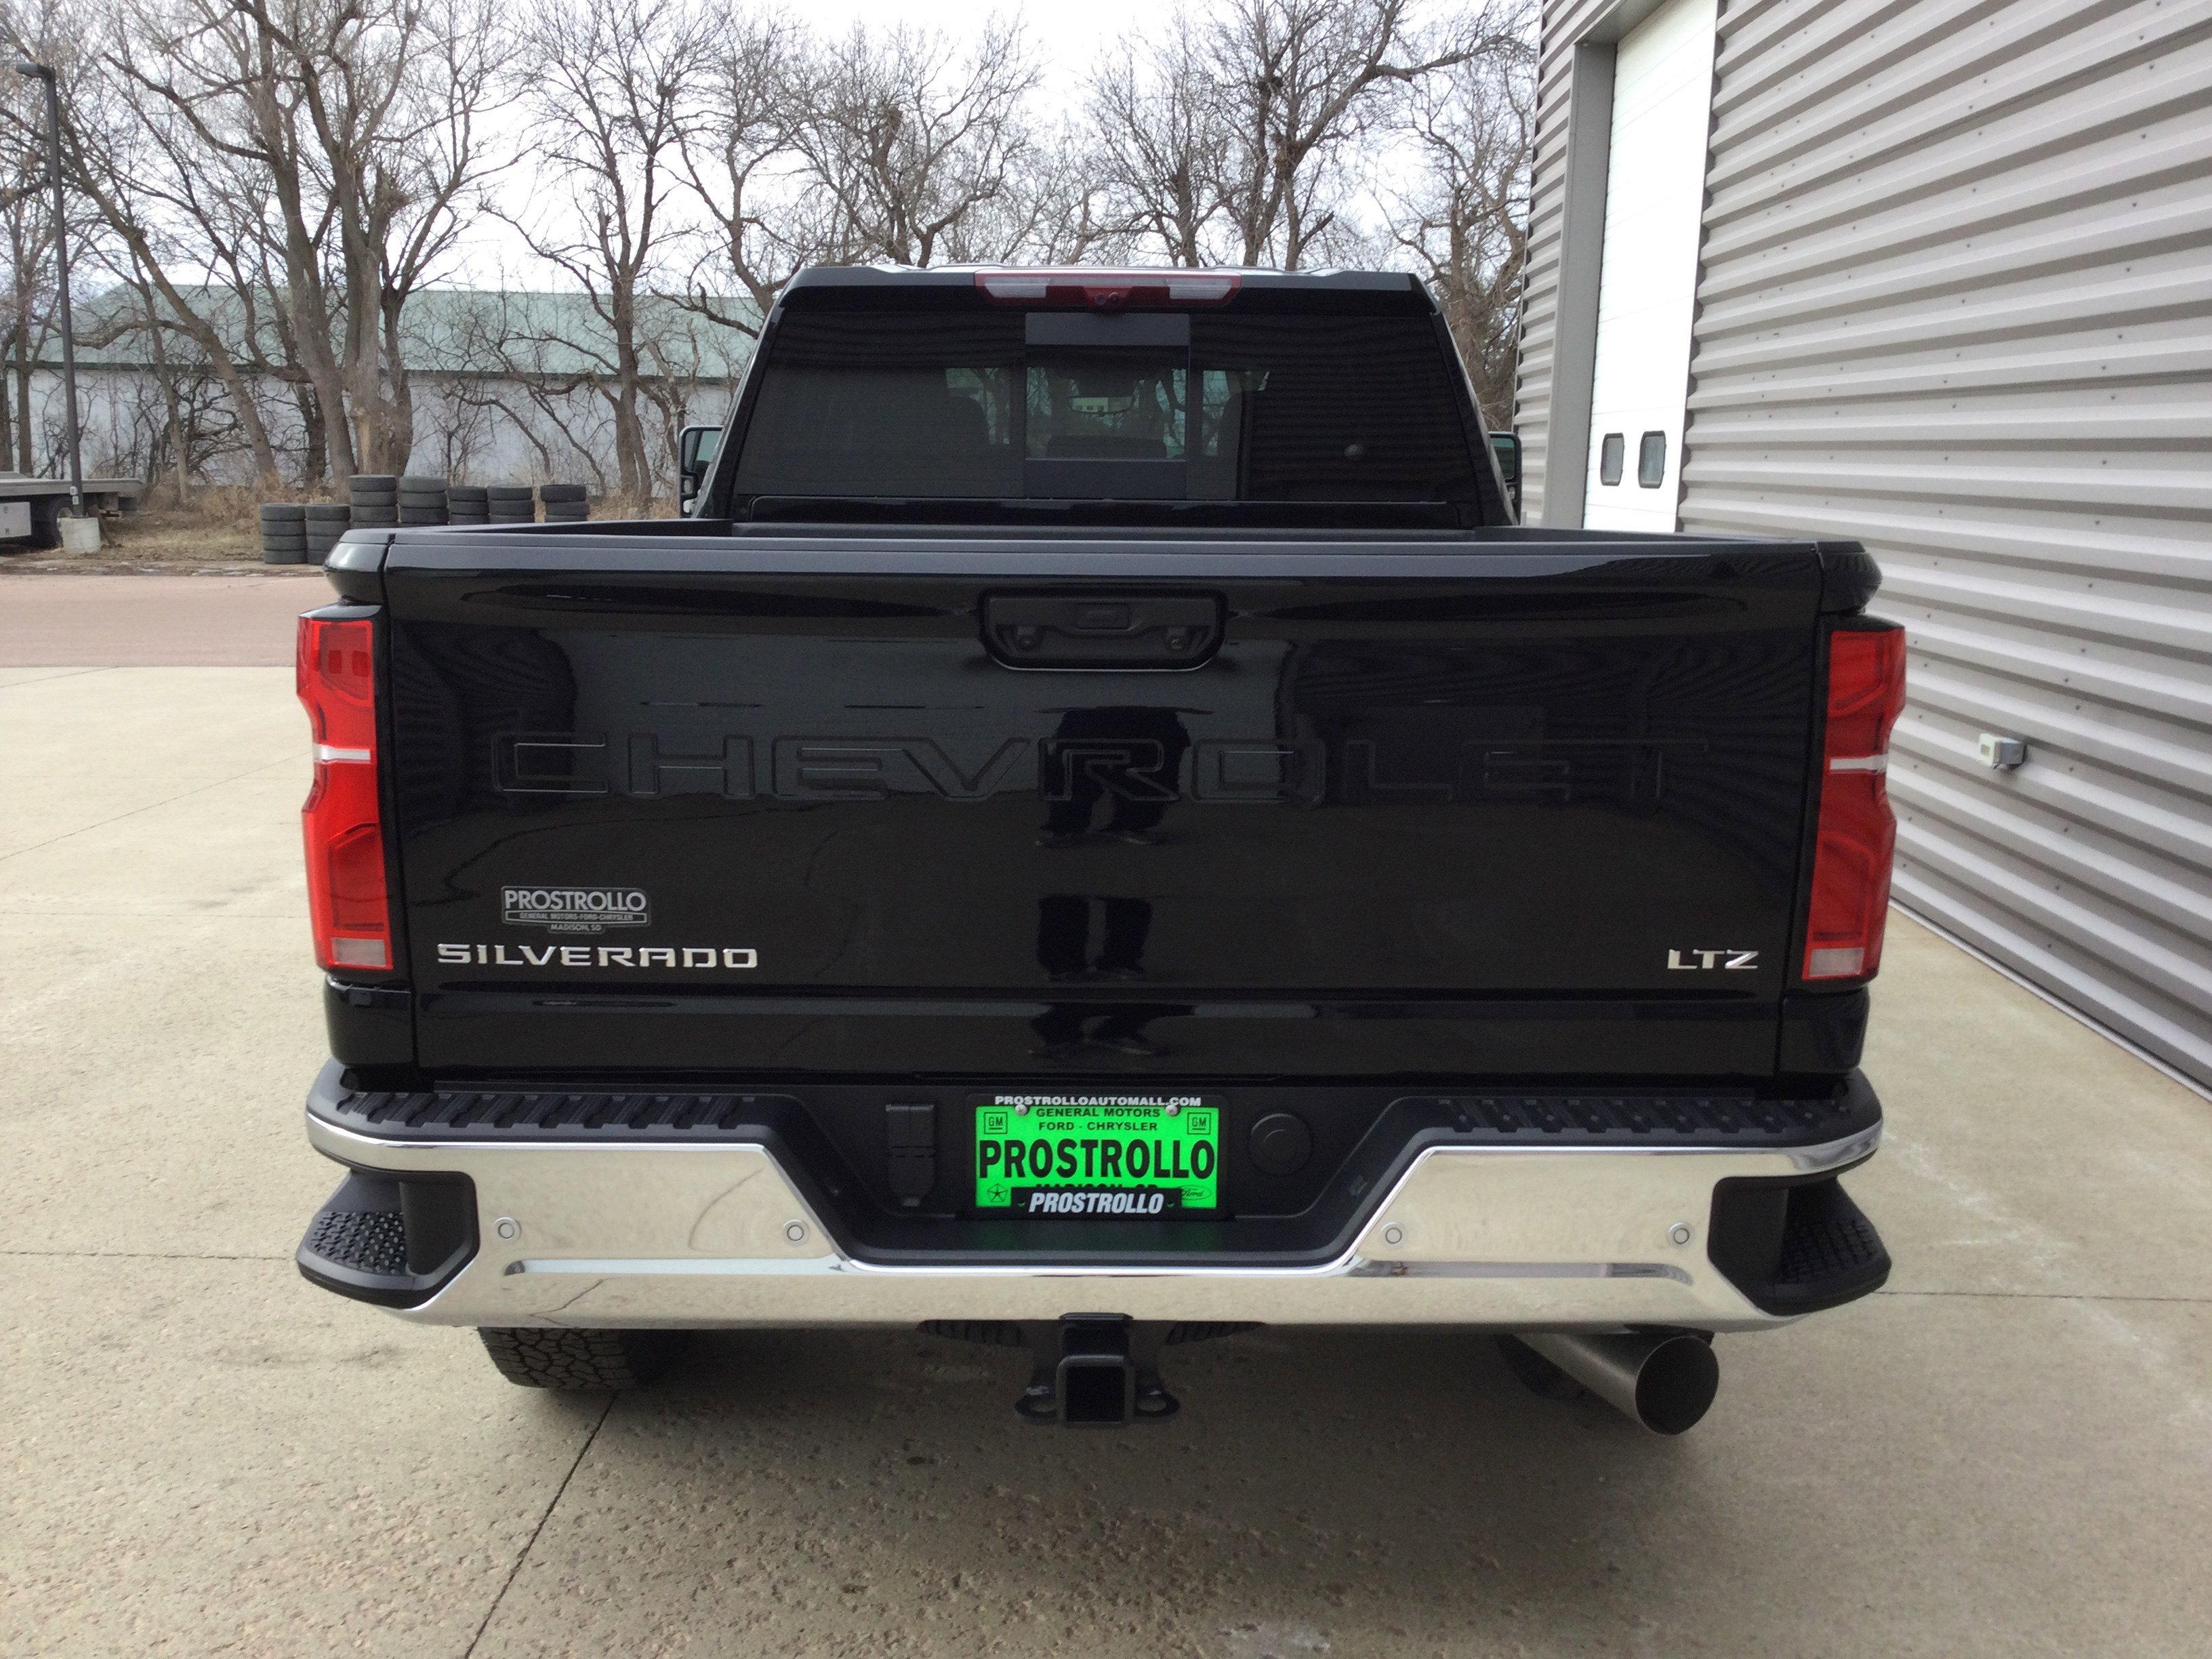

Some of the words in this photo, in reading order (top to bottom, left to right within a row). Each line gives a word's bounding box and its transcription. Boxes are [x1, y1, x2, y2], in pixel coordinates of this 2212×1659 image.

[491, 731, 1709, 804] CHEVROLET
[504, 890, 647, 912] PROSTROLLO
[437, 943, 758, 968] SILVERADO
[1667, 949, 1759, 969] LTZ
[994, 1096, 1202, 1107] PROSTROLLOAUTOMALL.COM
[988, 1116, 1004, 1127] GM
[1036, 1107, 1100, 1118] GENERAL
[1104, 1107, 1161, 1118] MOTORS
[1191, 1116, 1207, 1127] GM
[1038, 1122, 1075, 1131] FORD
[1086, 1122, 1158, 1131] CHRYSLER
[979, 1139, 1215, 1179] PROSTROLLO
[1028, 1192, 1165, 1214] PROSTROLLO
